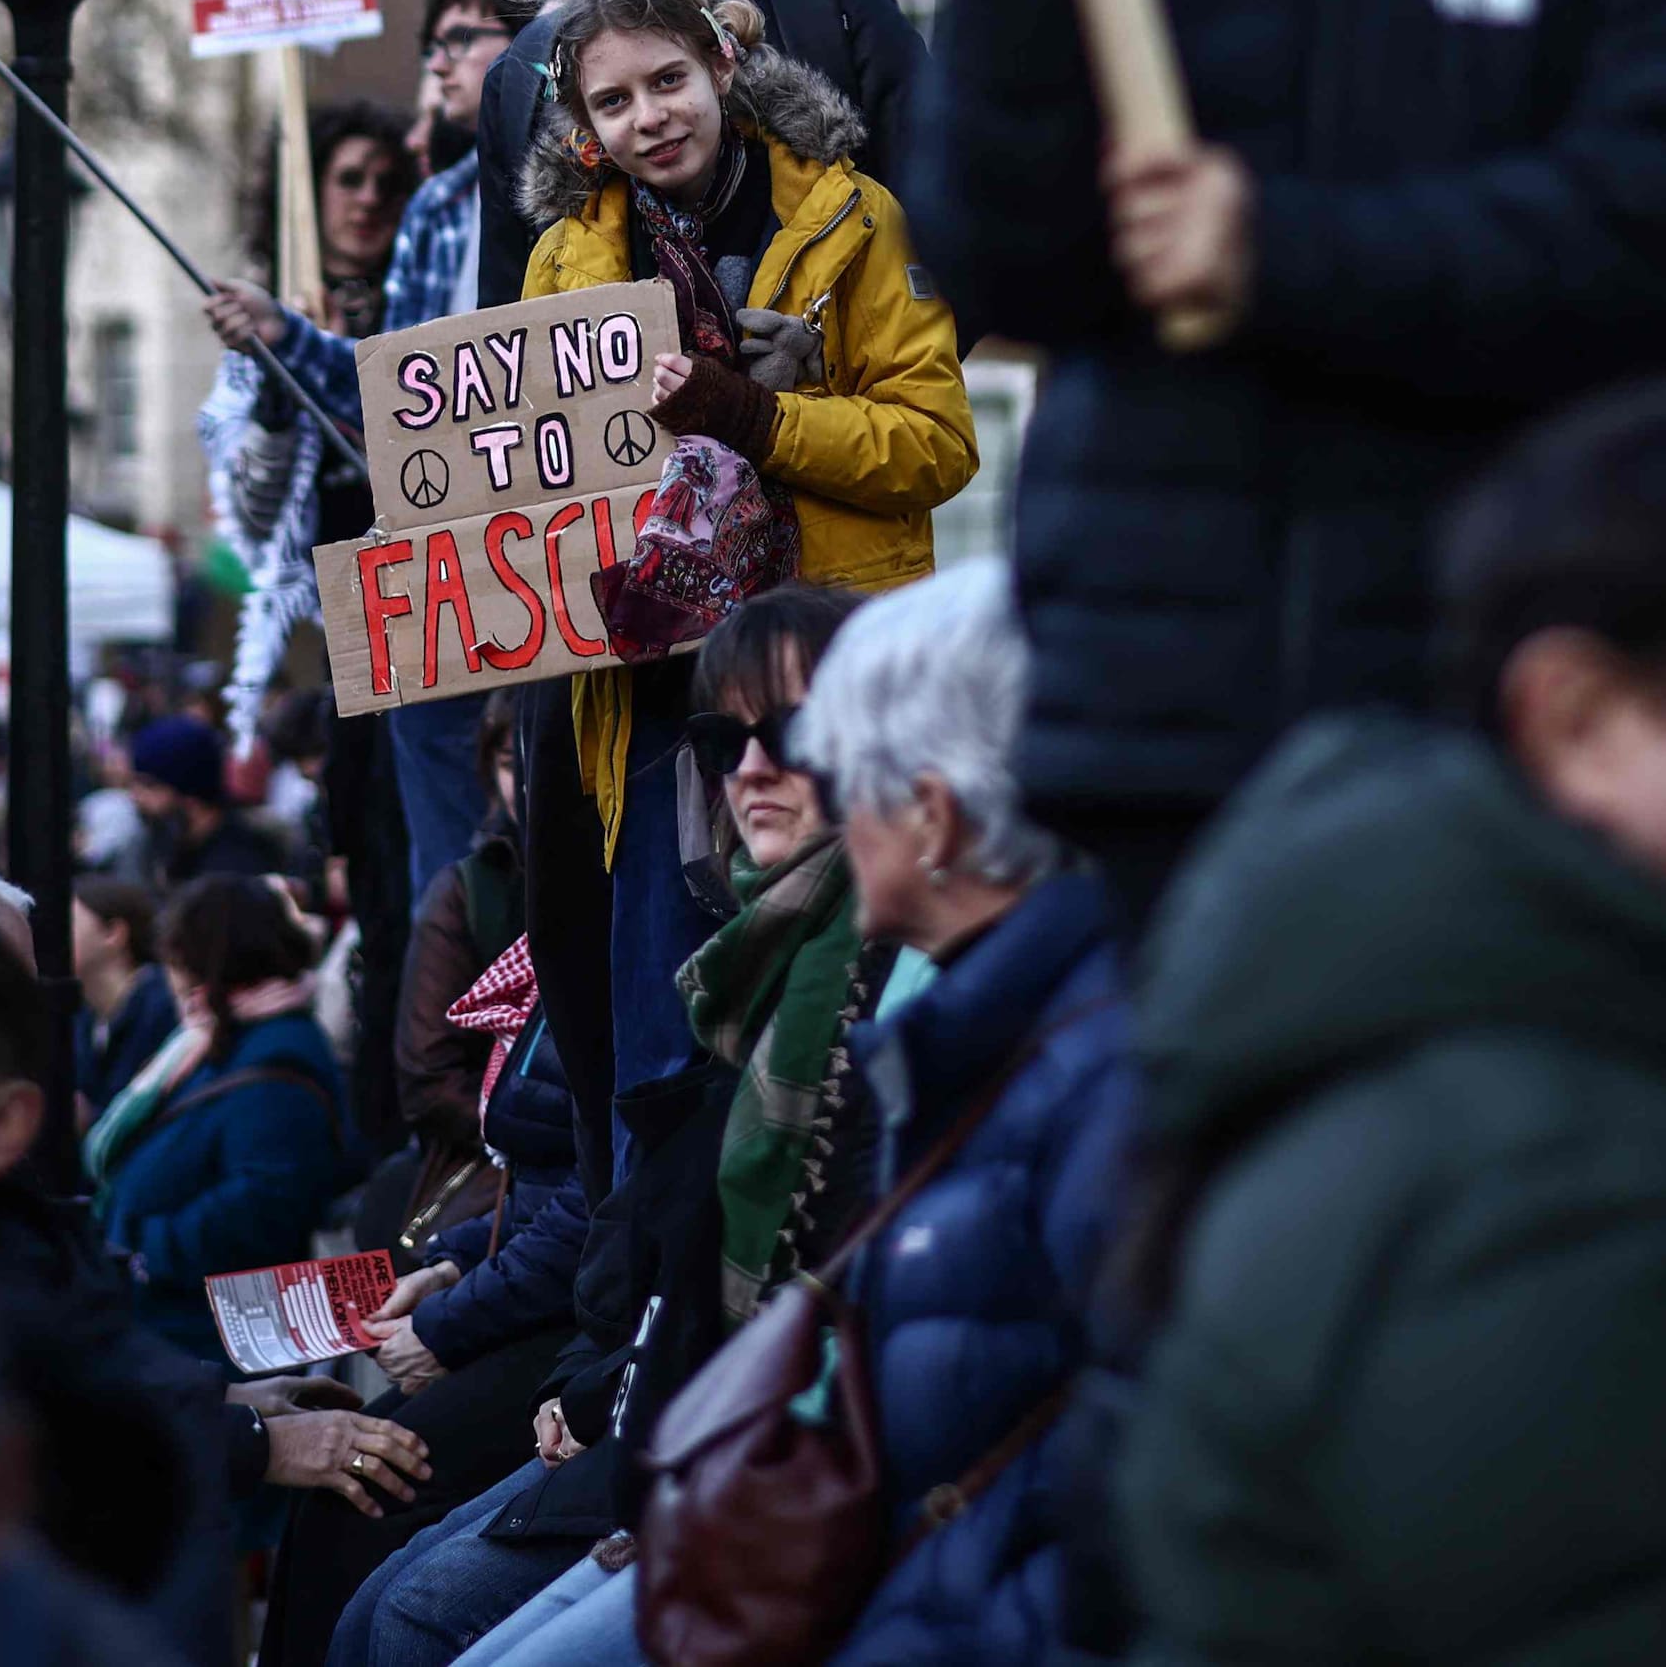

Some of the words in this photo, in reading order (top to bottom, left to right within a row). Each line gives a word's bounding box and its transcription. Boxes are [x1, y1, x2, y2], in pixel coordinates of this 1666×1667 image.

[393, 327, 529, 431] SAY
[550, 312, 642, 398] NO
[469, 411, 573, 492] TO
[373, 1256, 390, 1285] ARE
